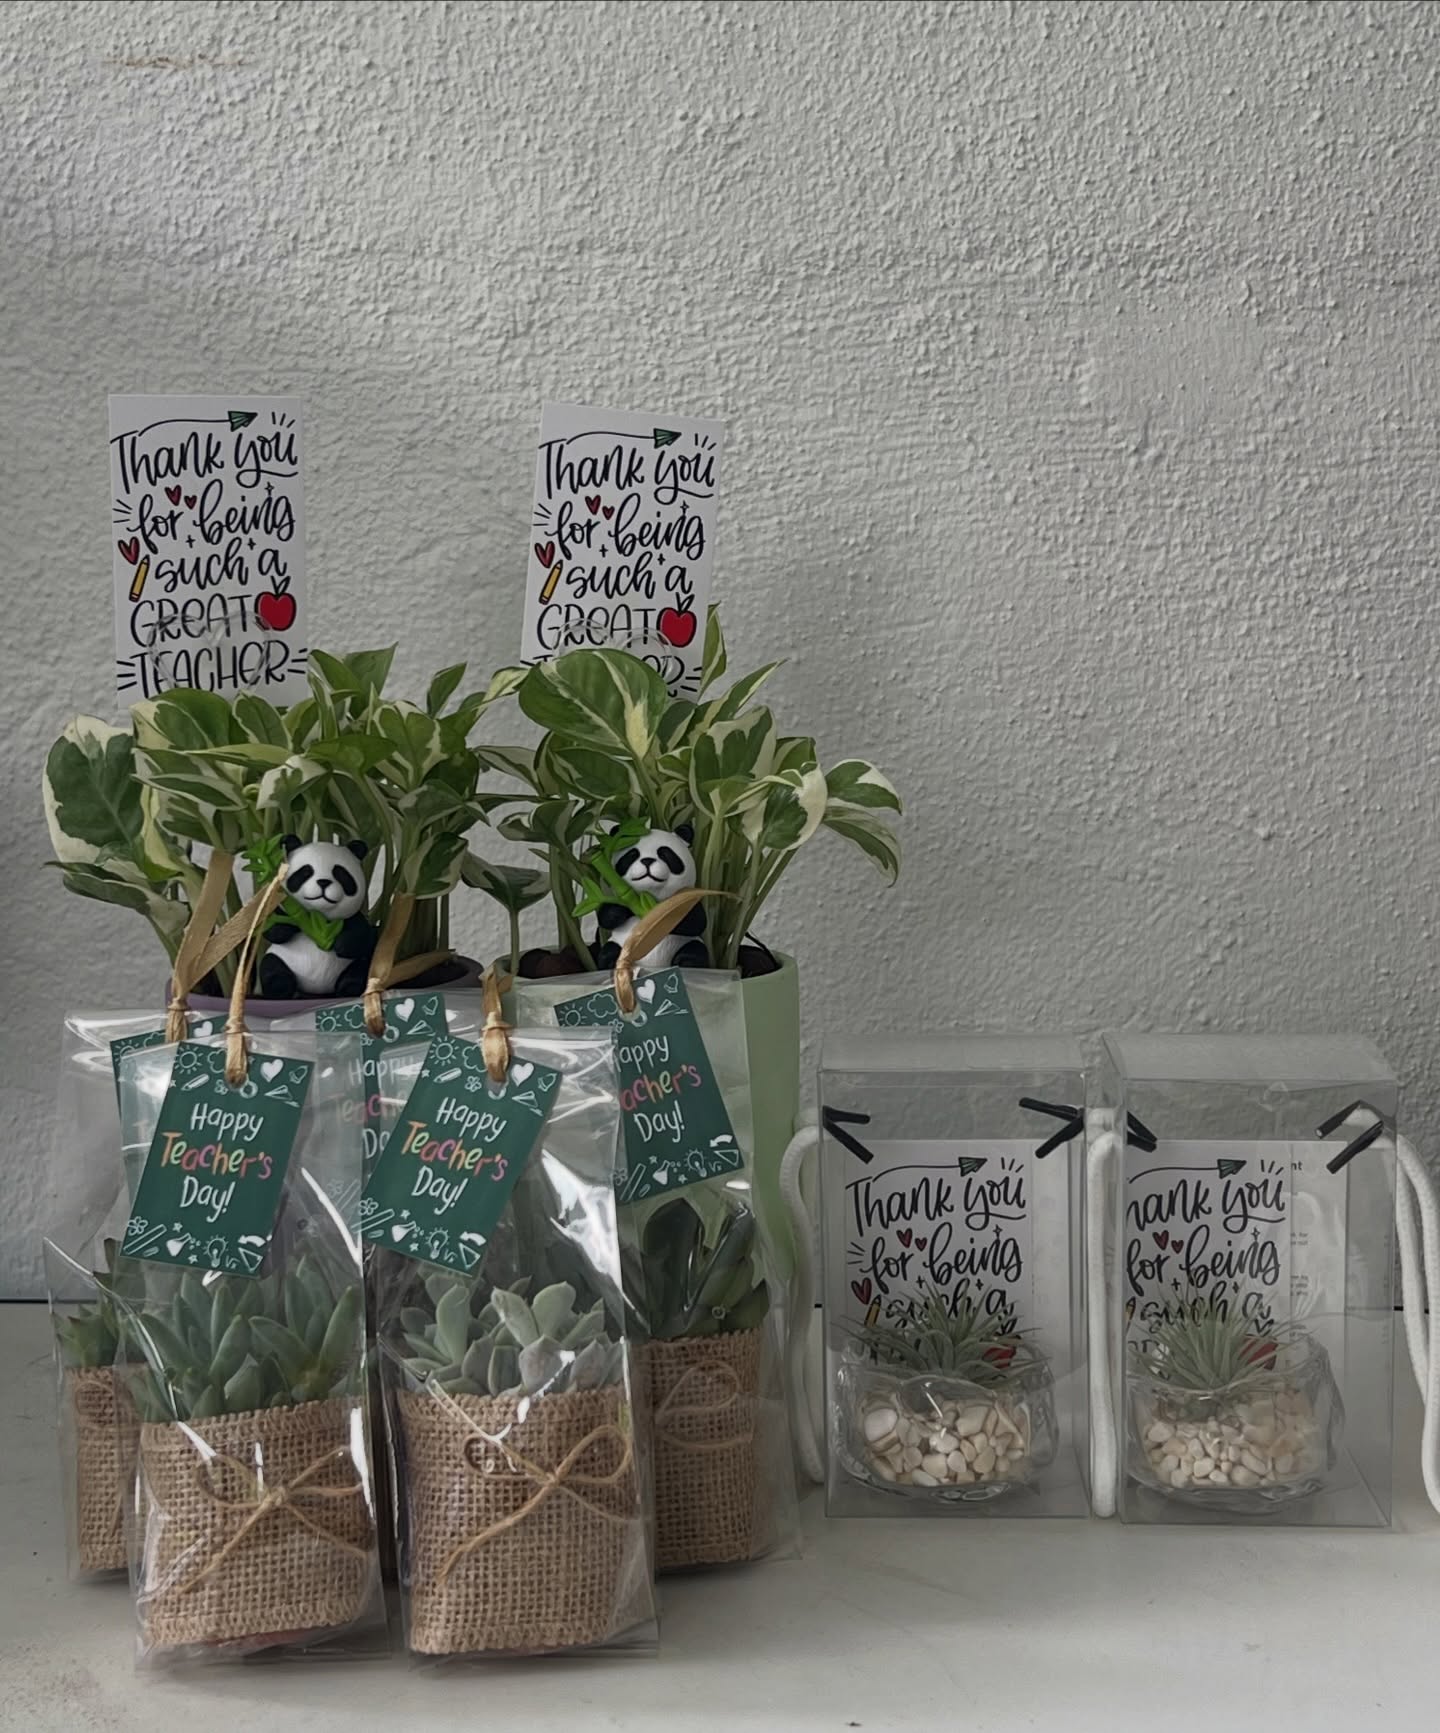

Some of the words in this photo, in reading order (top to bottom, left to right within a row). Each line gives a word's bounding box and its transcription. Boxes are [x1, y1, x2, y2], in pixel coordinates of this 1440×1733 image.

[110, 430, 224, 494] Thank
[234, 431, 299, 488] you
[538, 438, 645, 499] Thank
[654, 450, 714, 505] you
[126, 493, 184, 555] for
[192, 478, 296, 545] being
[544, 500, 601, 560] for
[607, 492, 706, 560] being
[155, 536, 249, 592] such
[257, 548, 288, 577] a
[565, 551, 656, 599] such
[664, 565, 693, 595] a
[130, 593, 253, 647] GREAT
[536, 603, 657, 651] GREAT
[129, 639, 290, 699] TEACHER
[612, 1034, 670, 1073] appy
[189, 1103, 264, 1142] Happy
[435, 1096, 508, 1143] Happy
[633, 1100, 686, 1144] Day!
[161, 1131, 273, 1179] Teacher's
[401, 1120, 509, 1181] Teacher's
[179, 1175, 236, 1223] Day!
[411, 1165, 469, 1216] Day!
[845, 1176, 954, 1237] Thank
[963, 1176, 1027, 1231] you
[1221, 1178, 1286, 1234] you
[859, 1236, 914, 1295] for
[922, 1221, 1023, 1286] being
[1126, 1238, 1171, 1298] for
[1178, 1223, 1281, 1288] being
